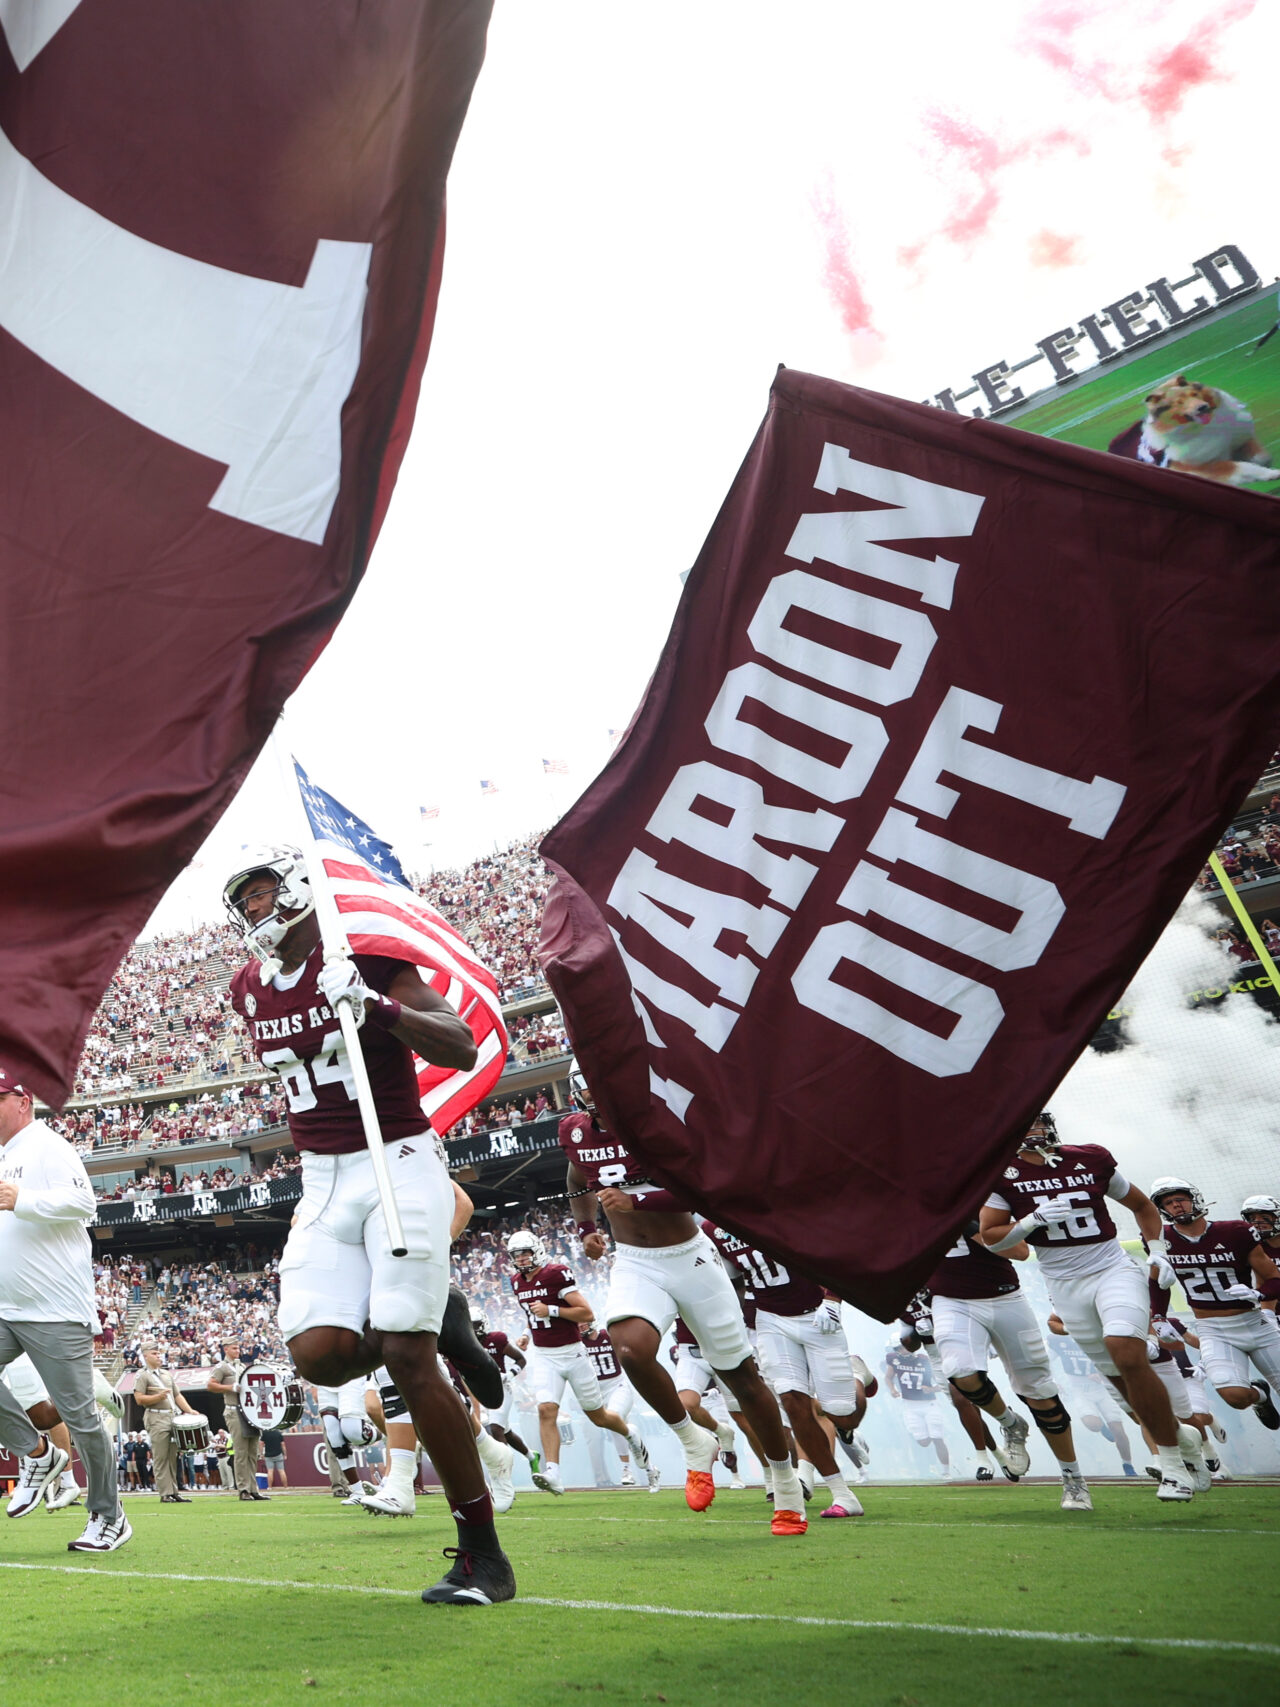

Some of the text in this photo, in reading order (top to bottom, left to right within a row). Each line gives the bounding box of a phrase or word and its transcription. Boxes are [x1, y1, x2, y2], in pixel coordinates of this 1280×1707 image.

[1035, 245, 1264, 388] FIELD
[791, 685, 1128, 1078] OUT
[261, 1029, 358, 1114] 84
[577, 1146, 615, 1162] TEXAS
[1013, 1173, 1095, 1193] TEXAS A&M
[736, 1249, 790, 1288] 10
[1168, 1252, 1235, 1265] TEXAS A&M
[1175, 1267, 1241, 1302] 20
[1070, 1357, 1092, 1375] 17
[900, 1372, 923, 1390] 47
